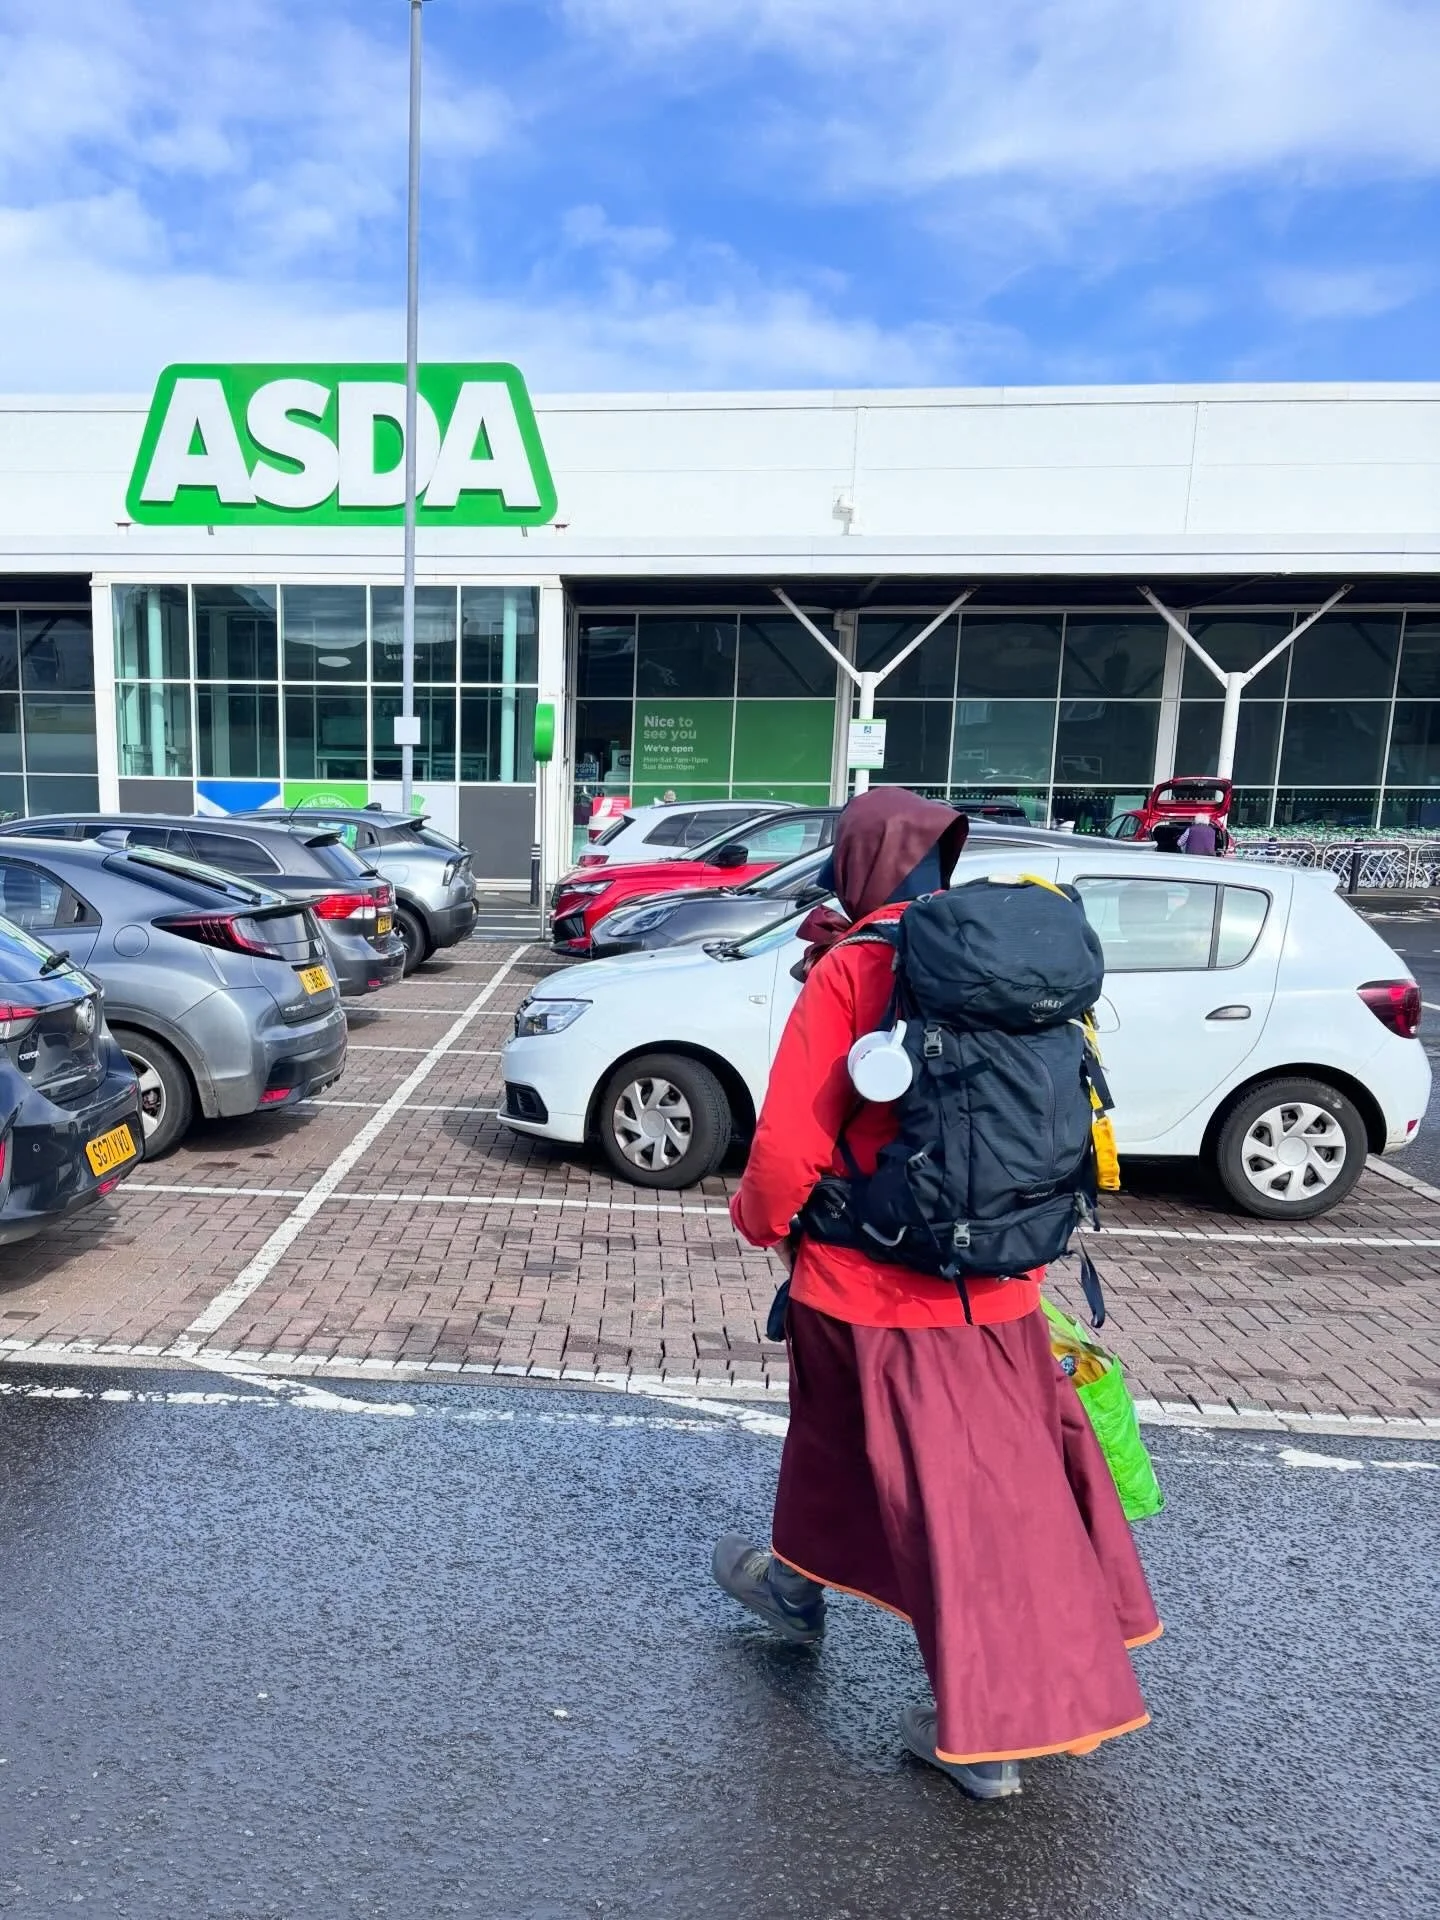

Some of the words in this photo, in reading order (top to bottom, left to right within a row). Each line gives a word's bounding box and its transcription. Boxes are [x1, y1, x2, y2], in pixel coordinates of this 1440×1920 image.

[140, 377, 542, 509] ASDA
[644, 715, 675, 727] Nice
[678, 716, 694, 727] to
[643, 730, 667, 739] see
[671, 730, 697, 741] you
[644, 744, 669, 752] We're
[1031, 1000, 1064, 1009] OSPREY
